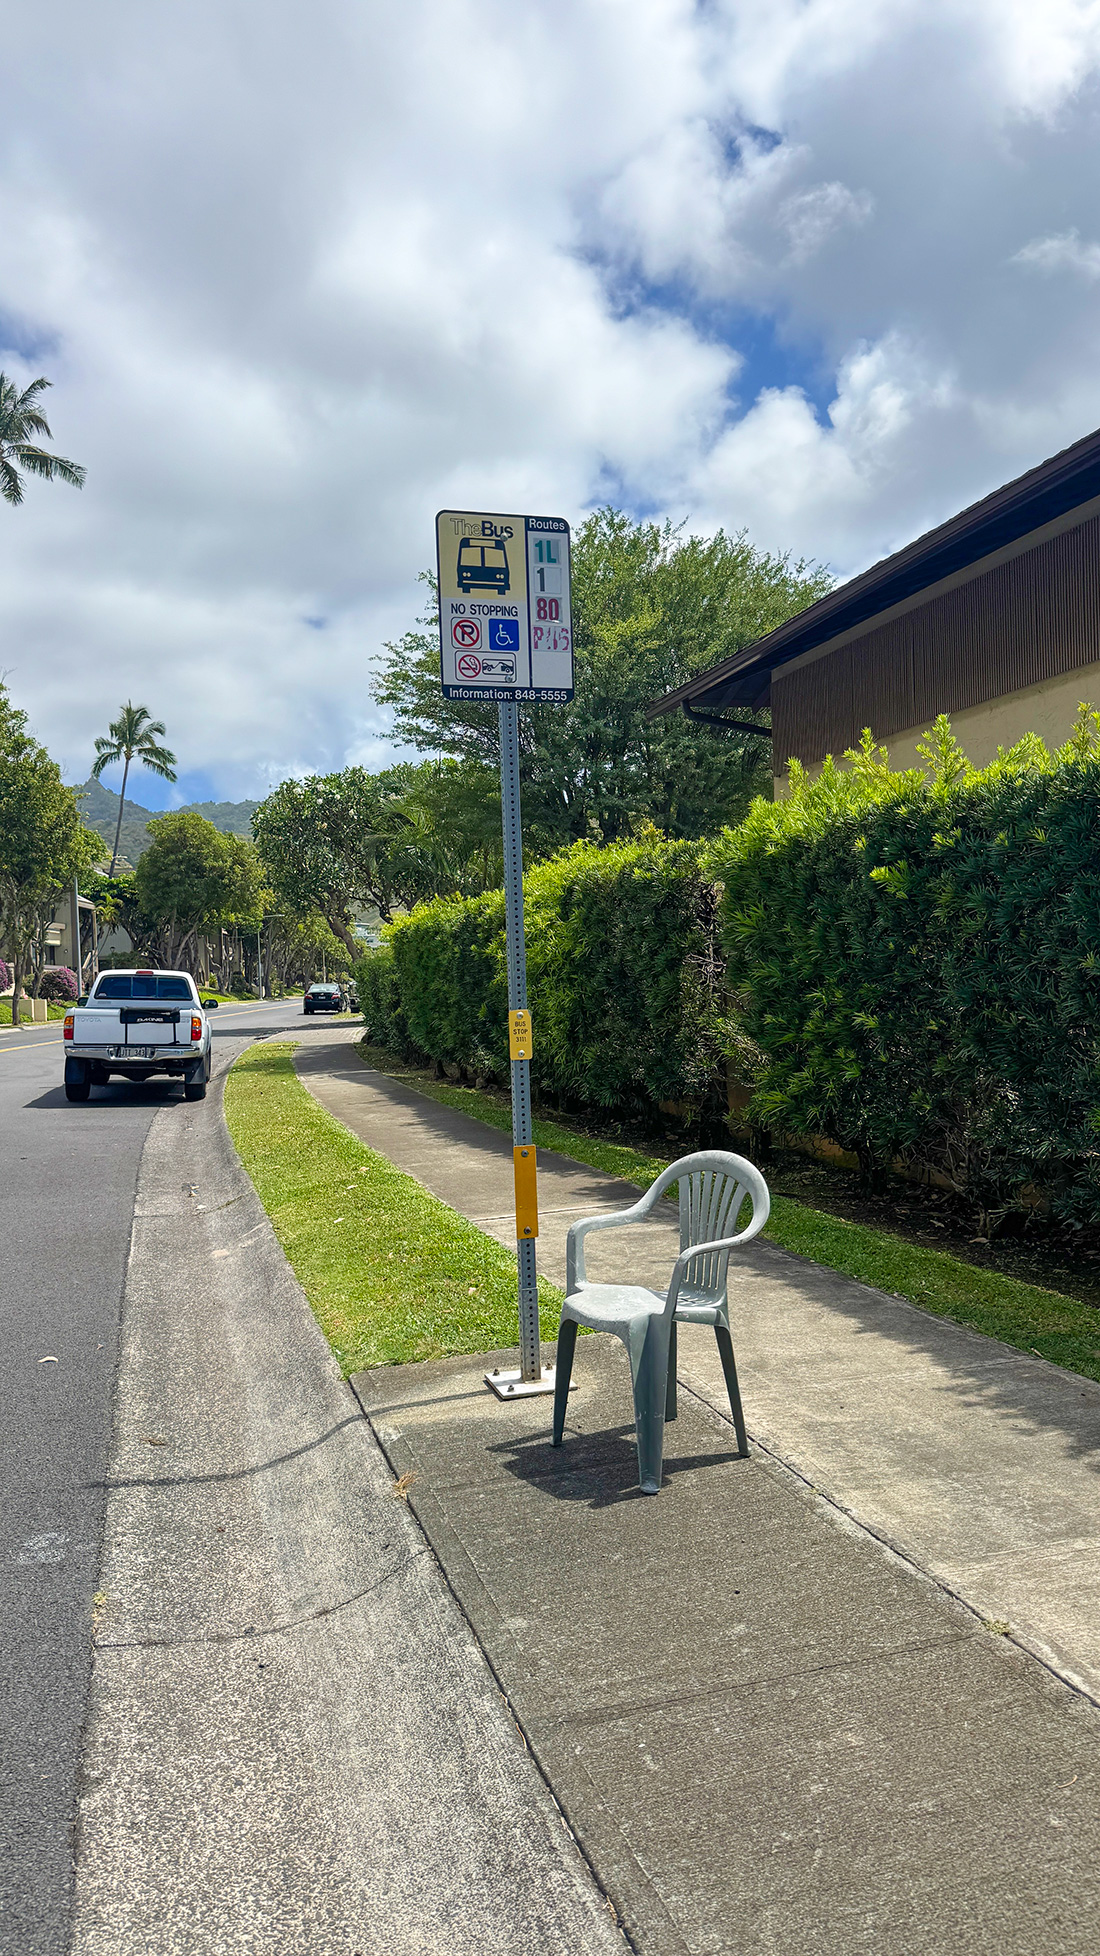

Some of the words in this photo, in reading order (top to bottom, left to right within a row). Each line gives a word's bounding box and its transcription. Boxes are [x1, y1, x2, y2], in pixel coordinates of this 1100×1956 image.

[529, 518, 565, 531] Routes
[534, 540, 557, 564] 1L
[536, 567, 545, 592] 1
[450, 603, 466, 615] NO
[469, 604, 519, 617] STOPPING
[537, 598, 559, 621] 80
[449, 687, 513, 700] Information:
[514, 689, 568, 701] 848-5555
